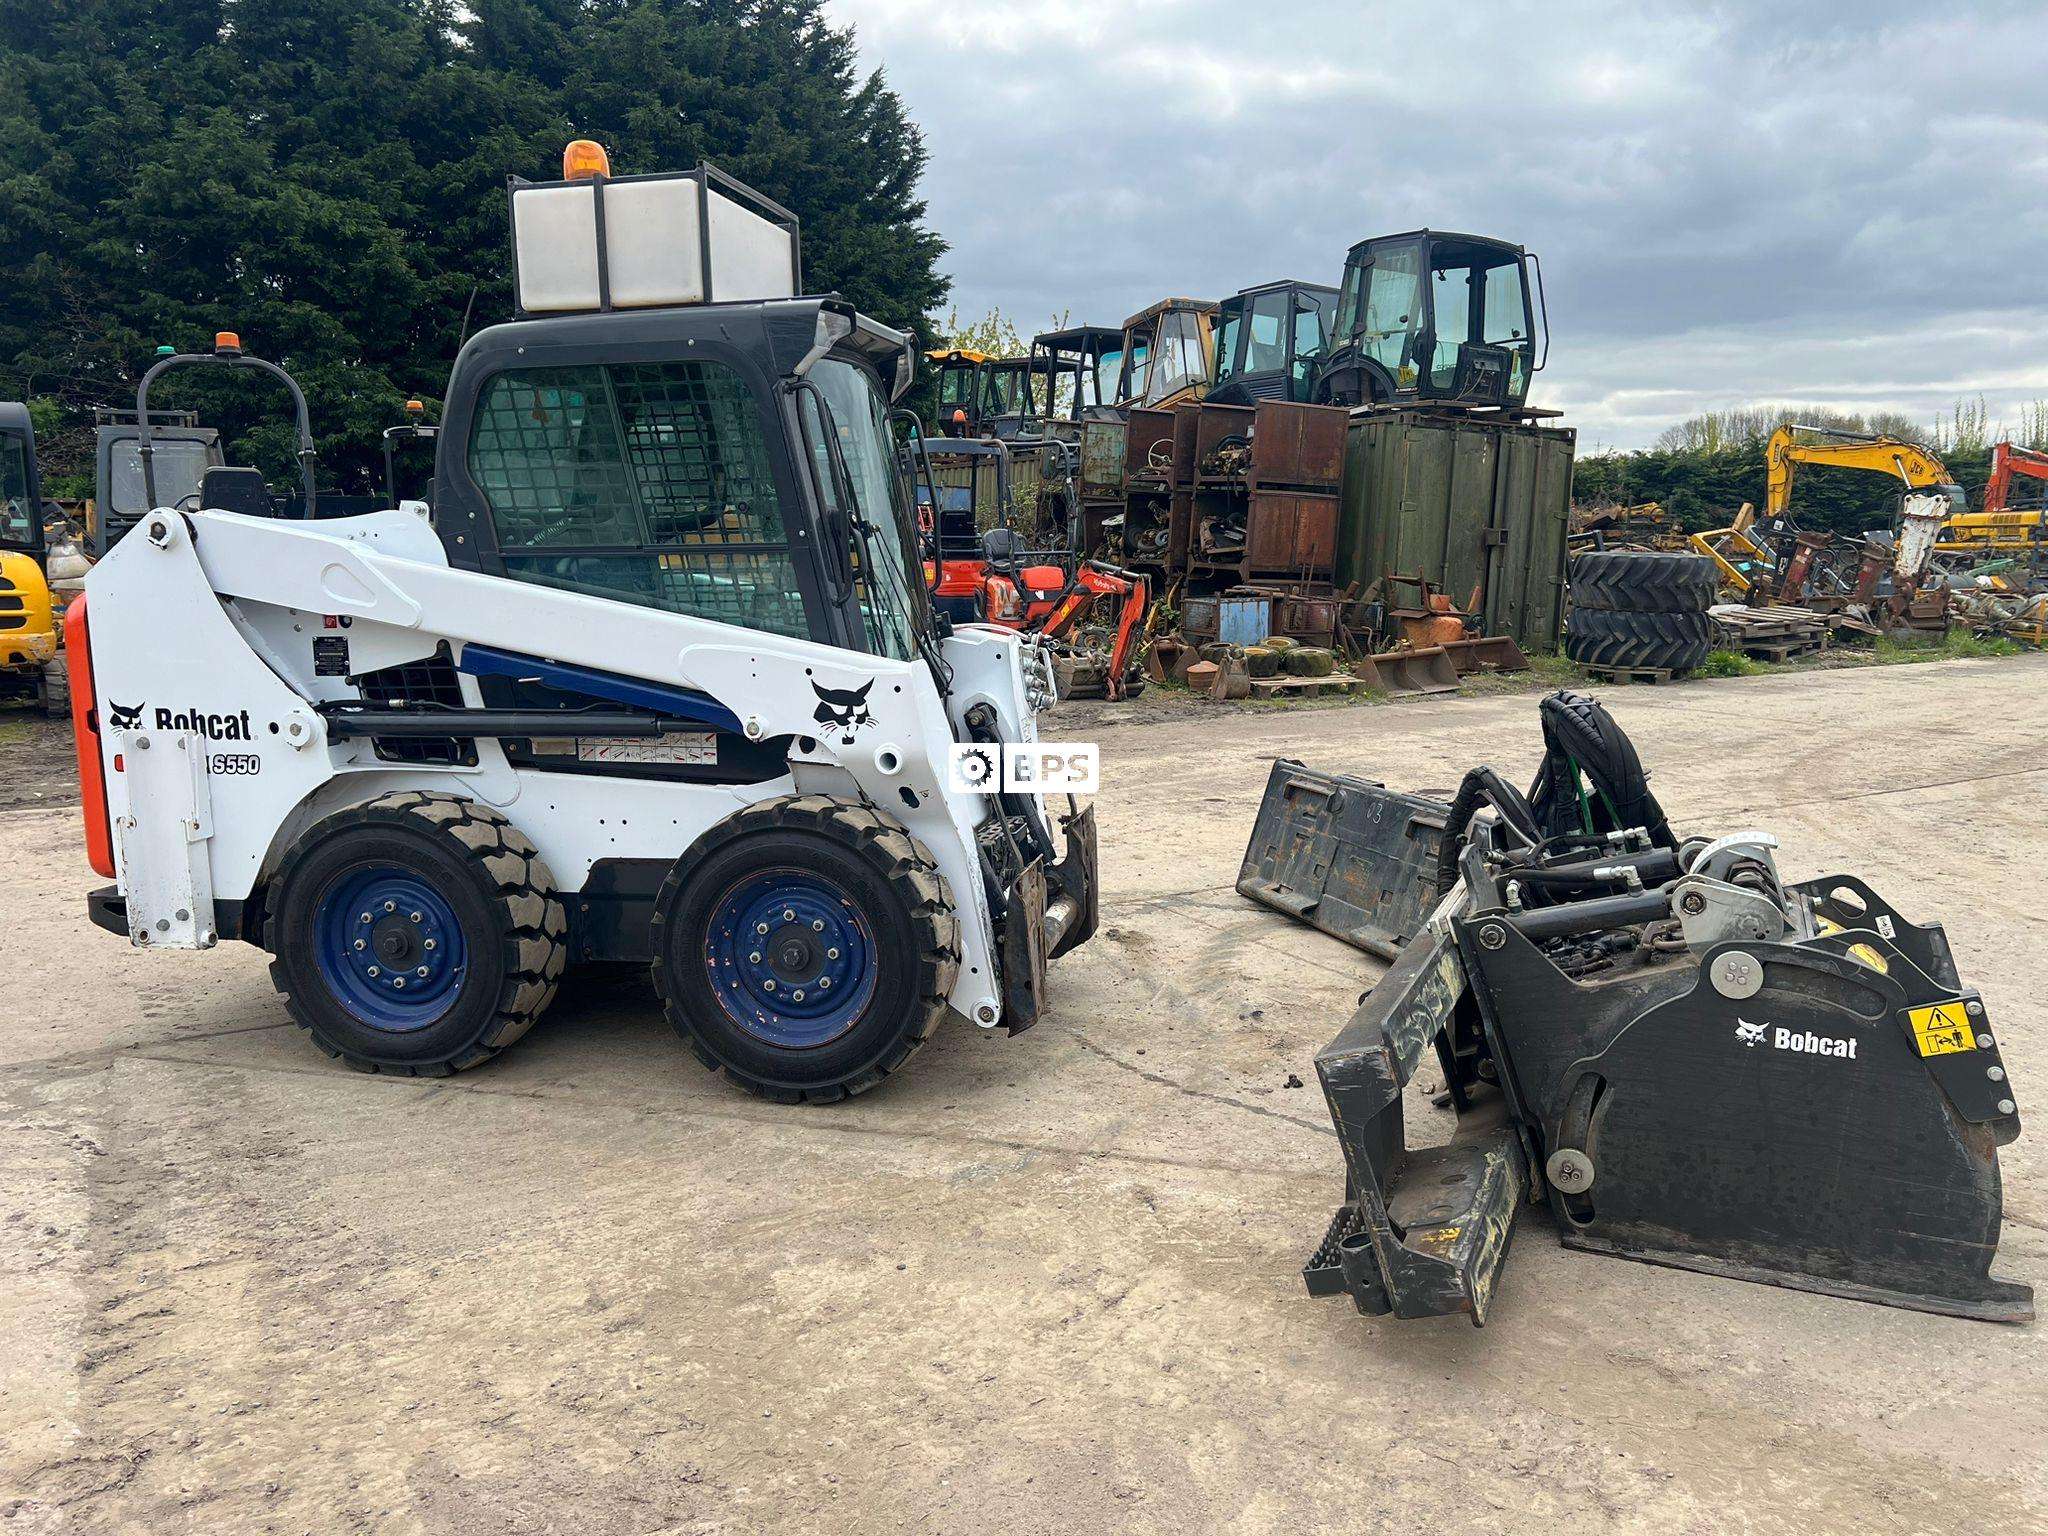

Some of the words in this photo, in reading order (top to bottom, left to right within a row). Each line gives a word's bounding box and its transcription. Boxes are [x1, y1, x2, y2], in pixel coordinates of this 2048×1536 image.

[1910, 461, 1925, 475] JCB
[155, 708, 251, 741] Bobcat
[212, 754, 261, 775] S550
[1774, 1027, 1858, 1060] Bobcat
